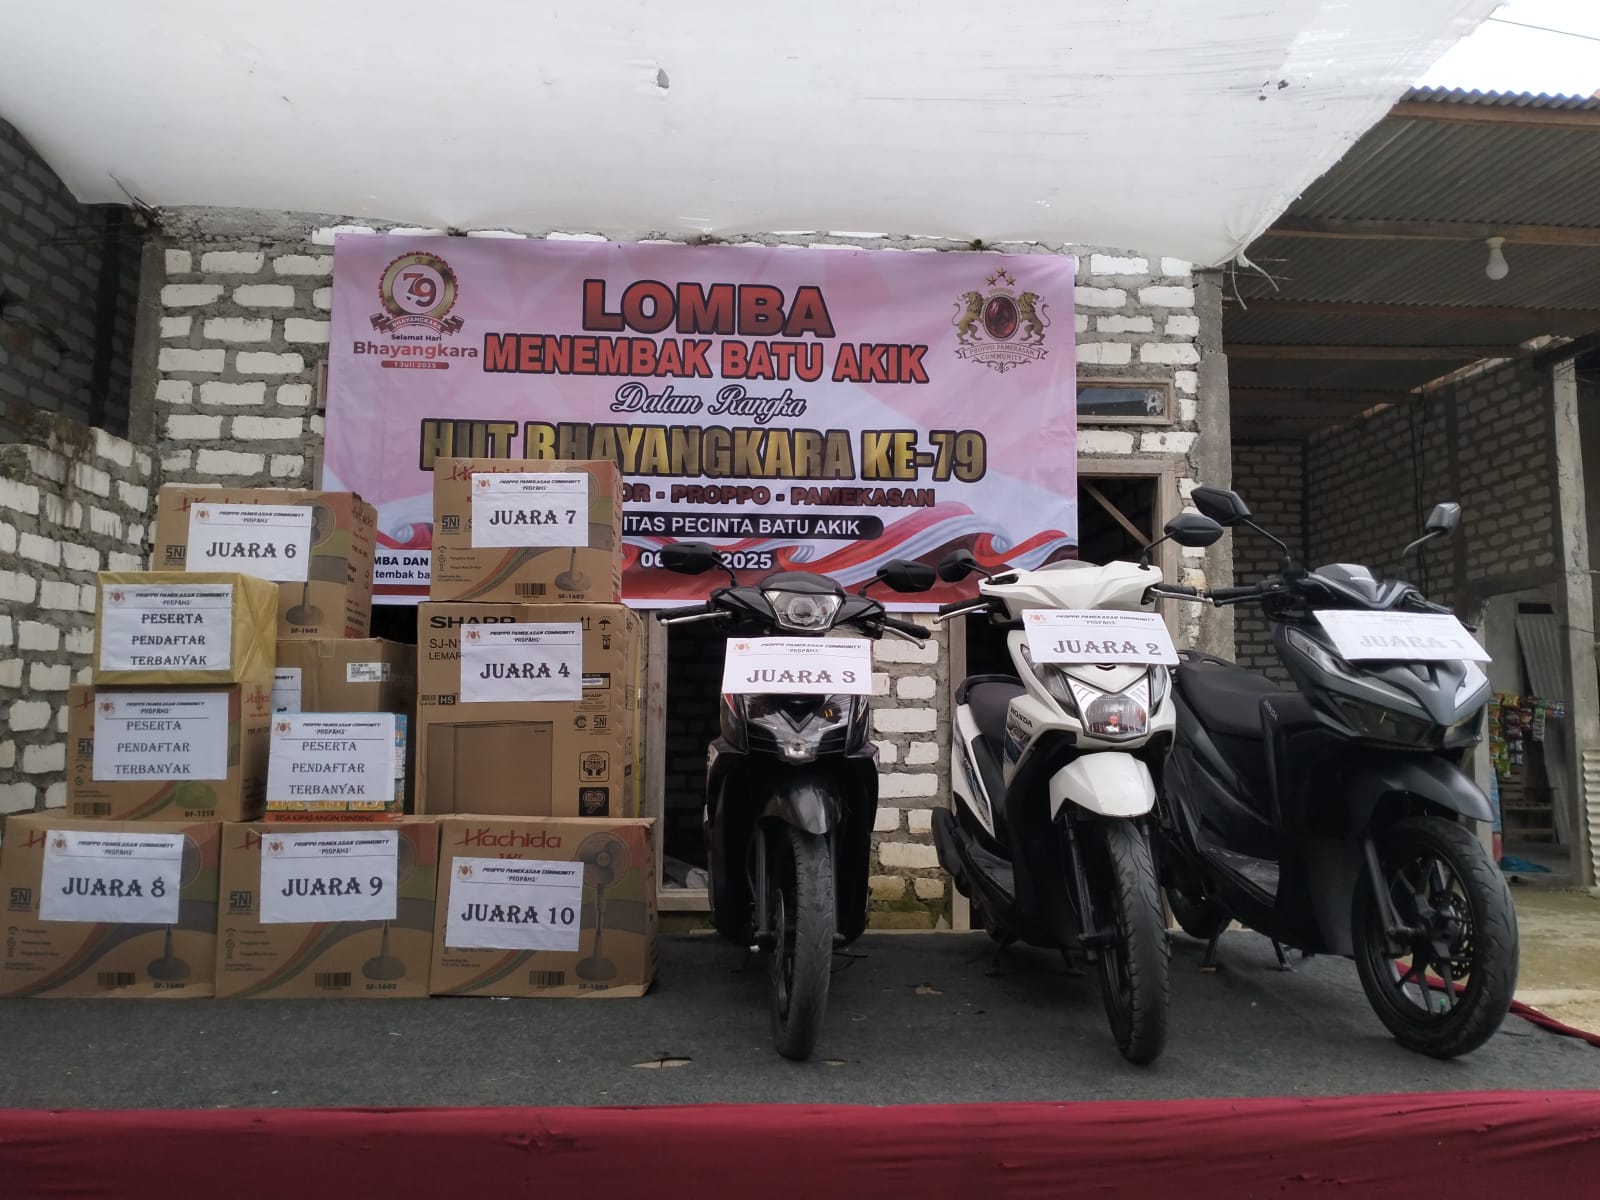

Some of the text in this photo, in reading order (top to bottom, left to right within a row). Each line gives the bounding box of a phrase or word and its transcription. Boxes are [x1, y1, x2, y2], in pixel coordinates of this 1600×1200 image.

[402, 272, 437, 307] 79
[582, 279, 836, 338] LOMBA
[391, 333, 423, 341] Selamat
[353, 341, 478, 359] Bhayangkara
[483, 332, 930, 384] MENEMBAK BATU AKIK
[610, 382, 807, 425] Dalam Rangka
[524, 420, 856, 481] BHAYANGKARA
[860, 428, 987, 483] KE-79
[670, 484, 771, 505] PROPPO
[790, 486, 936, 507] PAMEKASAN
[489, 510, 577, 525] JUARA 7
[623, 516, 860, 535] ITAS PECINTA BATU AKIK
[205, 542, 297, 559] JUARA 6
[375, 556, 429, 566] MBA DAN
[721, 552, 772, 569] 2025
[375, 570, 414, 579] tembak
[141, 613, 204, 624] PESERTA
[131, 635, 206, 645] PENDAFTAR
[429, 639, 460, 649] SJ-N
[1360, 635, 1465, 649] JUARA 1
[1053, 640, 1162, 656] JUARA 2
[130, 654, 207, 666] TERBANYAK
[480, 662, 570, 680] JUARA 4
[747, 669, 856, 684] JUARA 3
[440, 696, 454, 705] HS
[1010, 706, 1033, 728] HONDA
[126, 721, 182, 731] PESERTA
[117, 742, 190, 753] PENDAFTAR
[302, 741, 357, 751] PESERTA
[114, 763, 191, 775] TERBANYAK
[292, 763, 365, 773] PENDAFTAR
[289, 783, 365, 795] TERBANYAK
[455, 827, 562, 849] Hachida
[62, 876, 166, 898] JUARA 8
[281, 876, 383, 897] JUARA 9
[461, 903, 575, 925] JUARA 10
